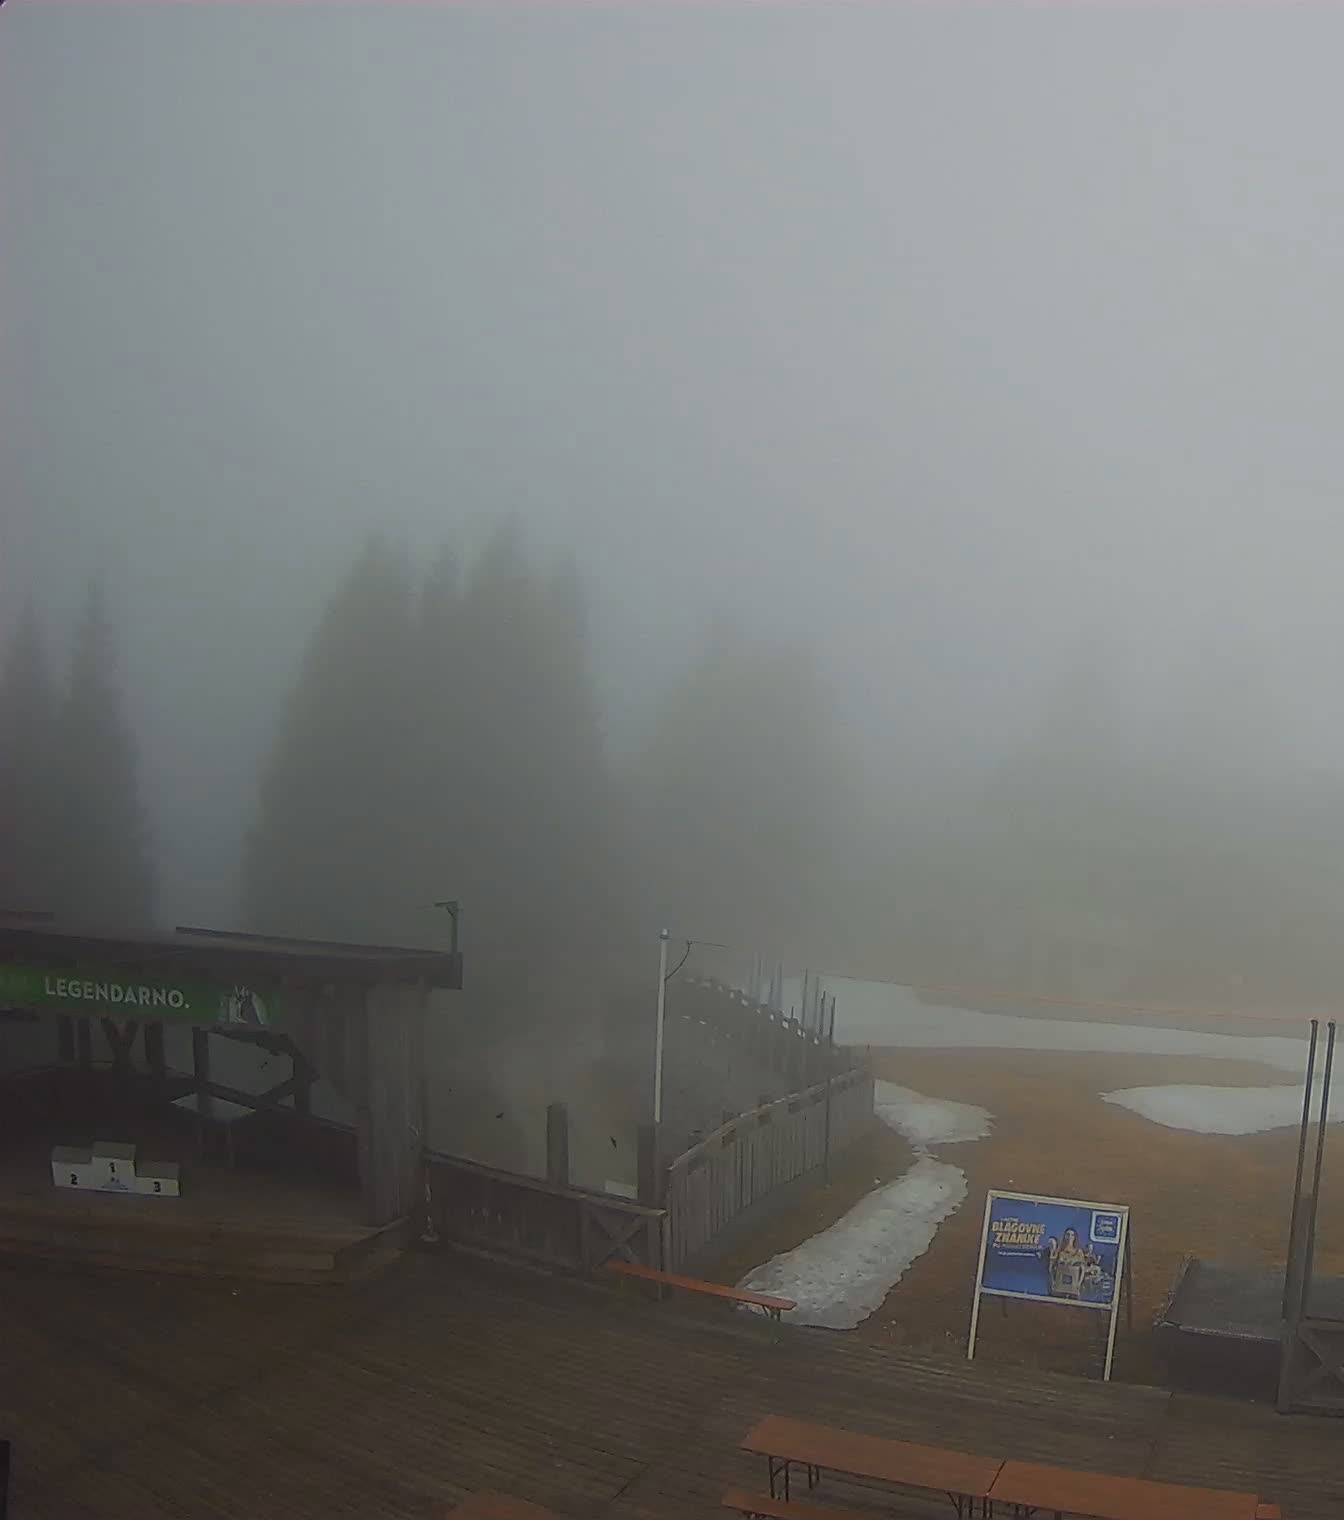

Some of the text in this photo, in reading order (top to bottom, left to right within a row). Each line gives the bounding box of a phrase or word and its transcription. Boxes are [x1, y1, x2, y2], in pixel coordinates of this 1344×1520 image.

[43, 975, 191, 1010] LEGENDARNO.
[109, 1162, 116, 1173] 1
[70, 1173, 79, 1186] 2
[153, 1181, 162, 1193] 3
